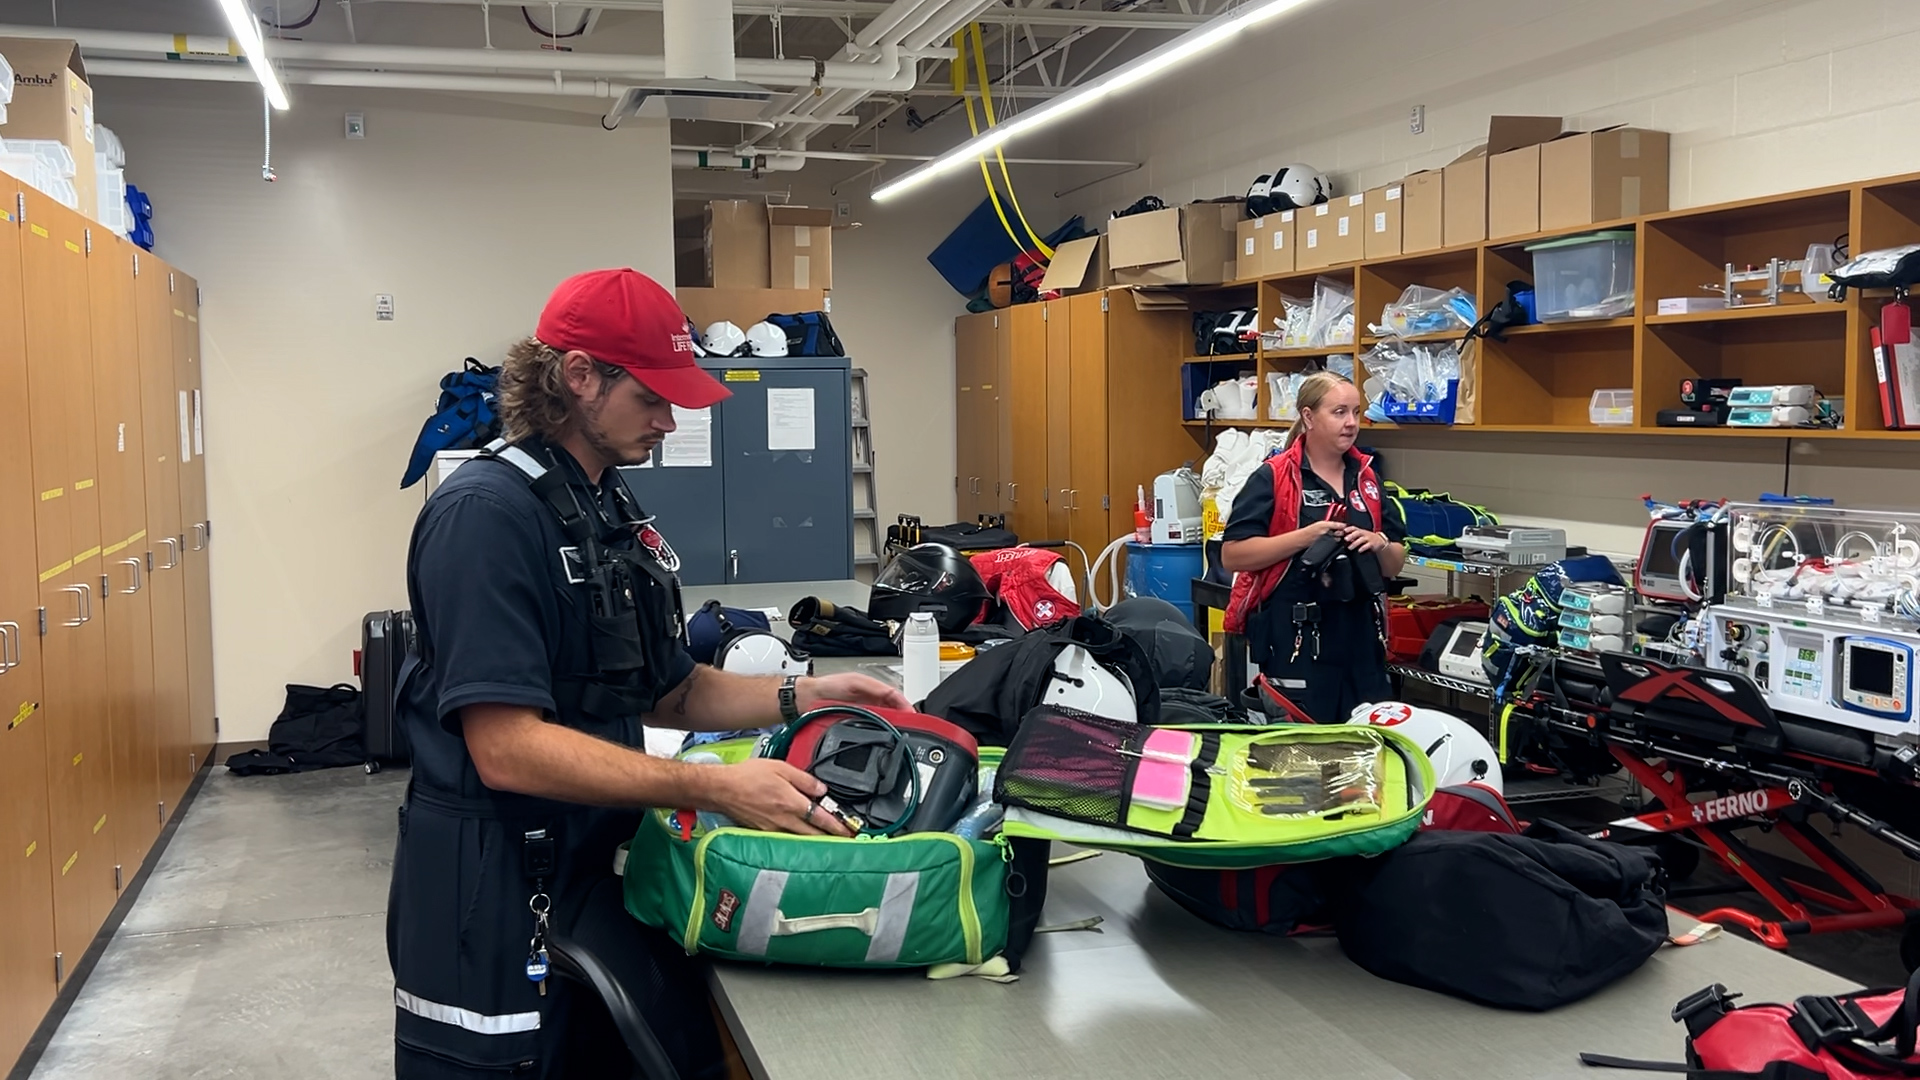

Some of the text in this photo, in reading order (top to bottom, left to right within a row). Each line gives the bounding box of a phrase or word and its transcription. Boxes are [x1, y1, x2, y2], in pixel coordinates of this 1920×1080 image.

[14, 73, 53, 84] Ambu
[672, 341, 688, 352] LIFE
[1705, 789, 1768, 822] FERNO
